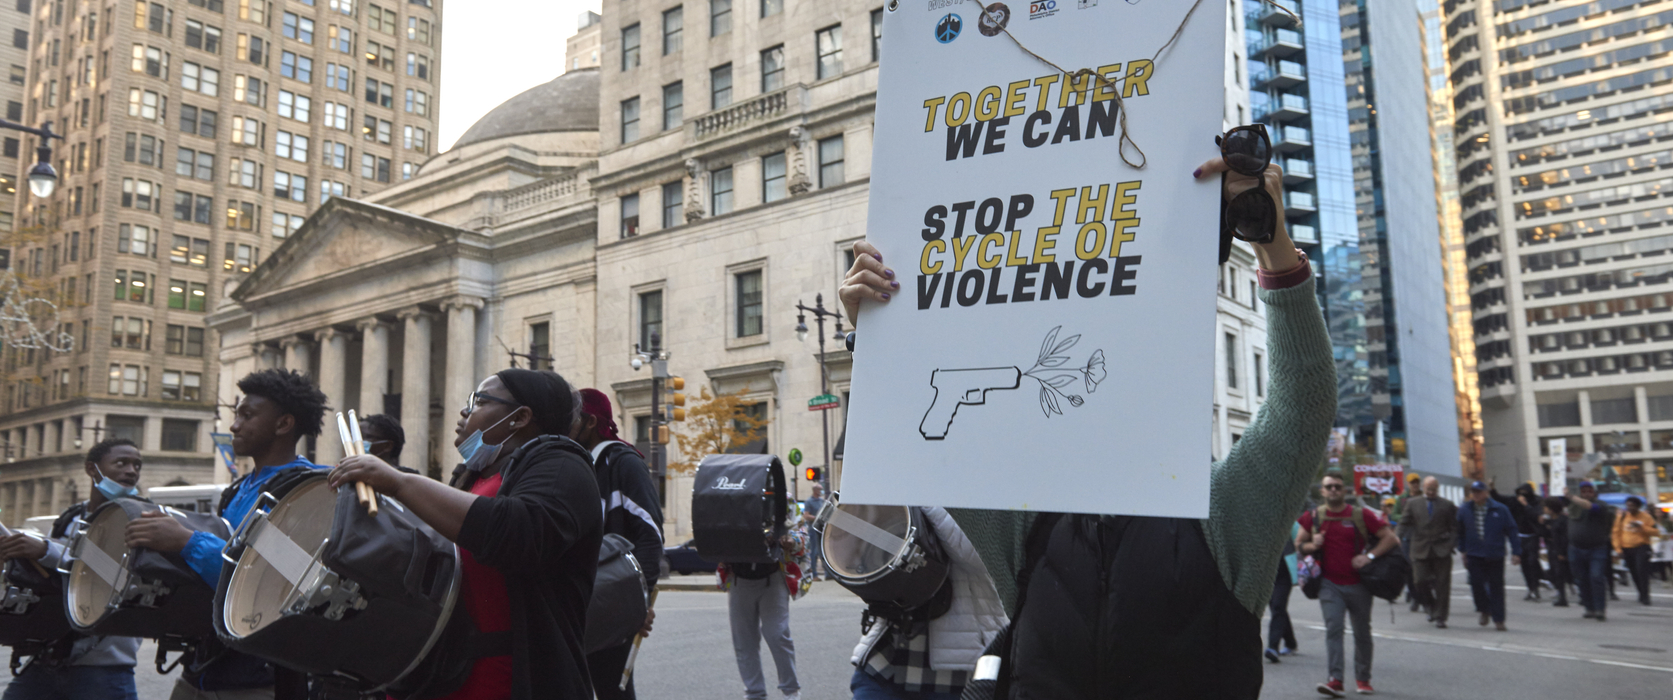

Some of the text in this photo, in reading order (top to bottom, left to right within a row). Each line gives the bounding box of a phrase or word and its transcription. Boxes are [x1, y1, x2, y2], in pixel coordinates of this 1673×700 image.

[1030, 0, 1057, 14] DAO
[923, 58, 1155, 133] TOGETHER
[945, 100, 1120, 162] WE CAN
[921, 180, 1142, 242] STOP THE
[920, 217, 1141, 275] CYCLE OF
[917, 255, 1142, 310] VIOLENCE
[711, 476, 747, 490] Pearl
